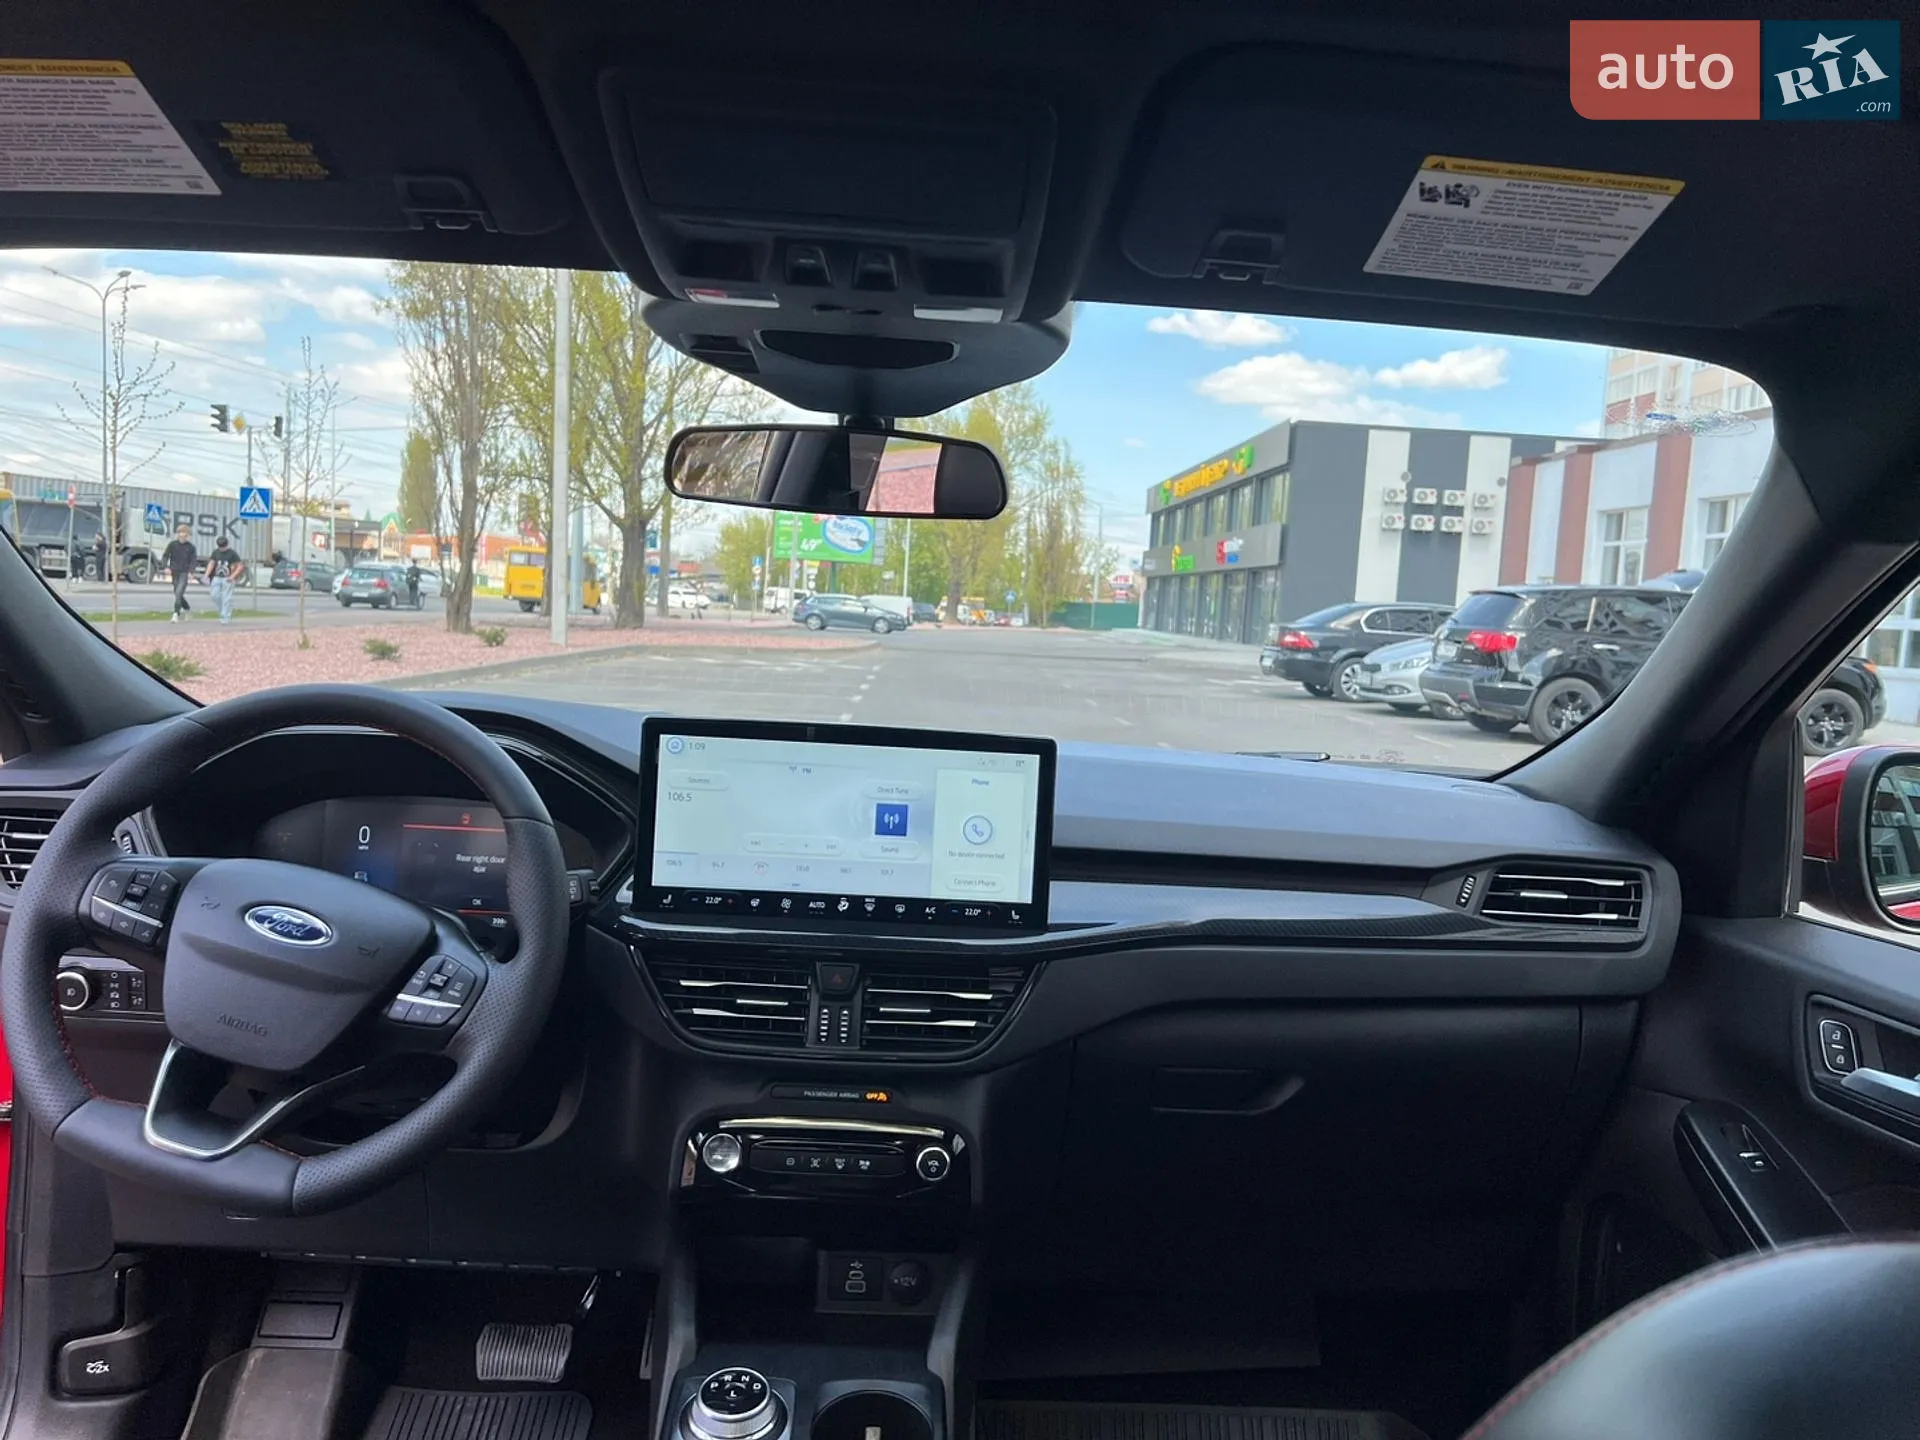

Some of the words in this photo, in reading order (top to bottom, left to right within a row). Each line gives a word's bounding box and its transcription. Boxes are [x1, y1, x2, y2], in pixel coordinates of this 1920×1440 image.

[163, 510, 241, 539] PSK
[667, 791, 693, 802] 106.5
[358, 825, 371, 844] 0
[808, 901, 826, 909] AUTO
[263, 911, 311, 937] Ford
[710, 1381, 719, 1389] P
[724, 1374, 733, 1382] R
[753, 1382, 762, 1390] D
